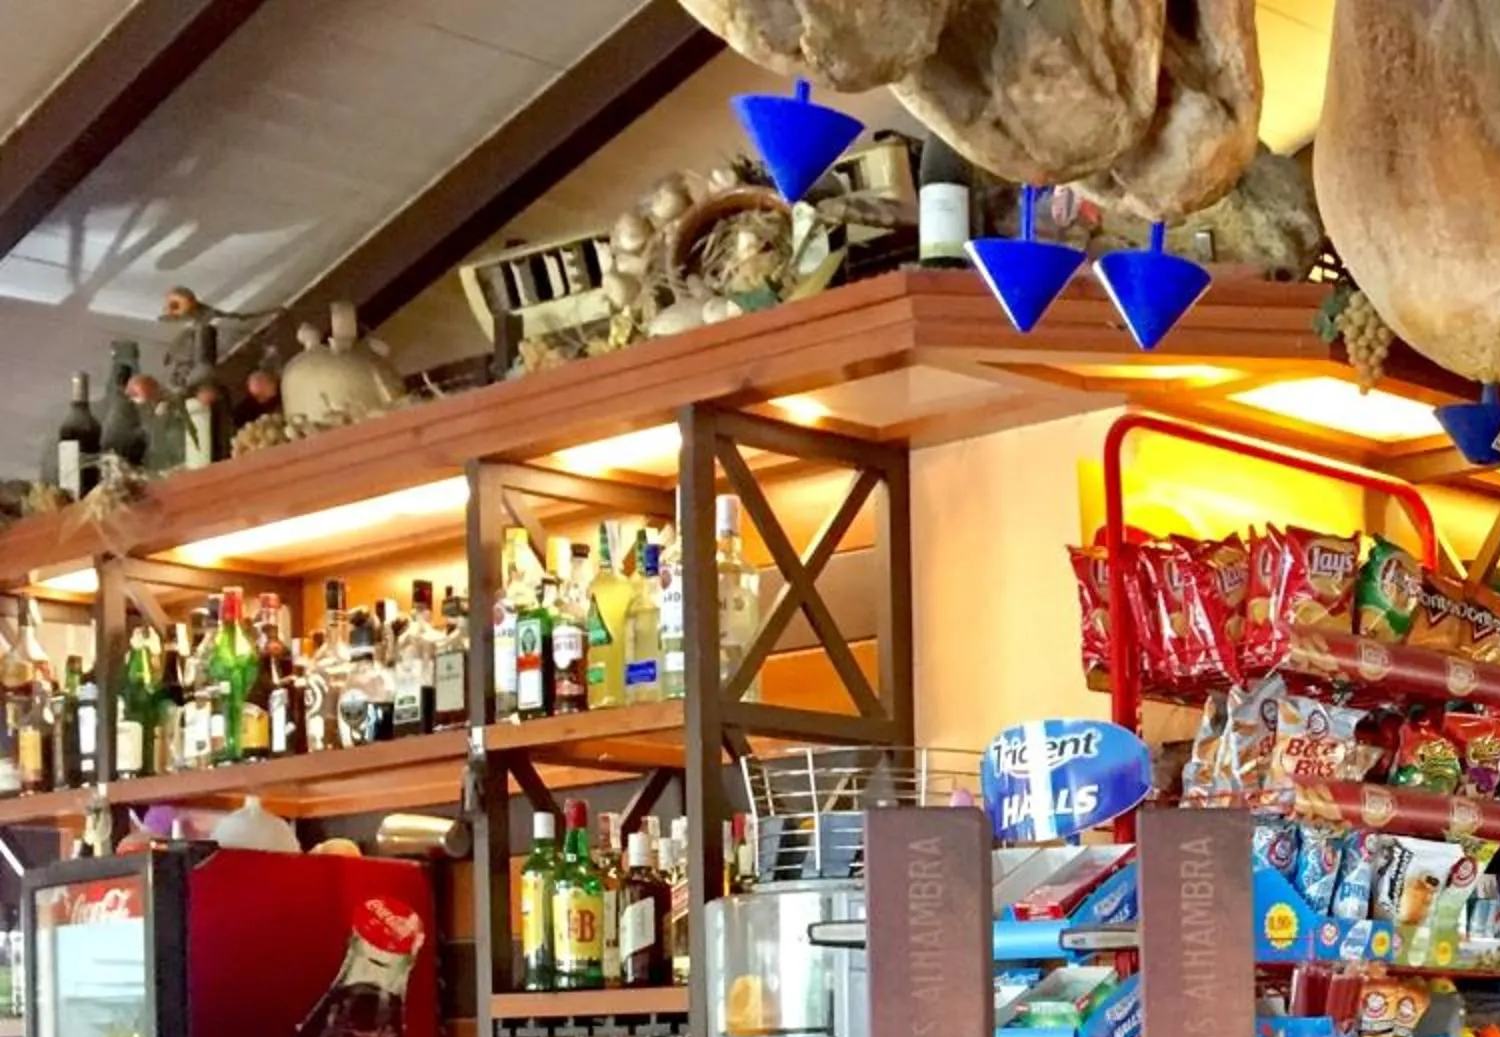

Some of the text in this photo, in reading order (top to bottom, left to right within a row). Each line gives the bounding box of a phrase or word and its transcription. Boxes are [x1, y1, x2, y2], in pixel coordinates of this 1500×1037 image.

[1001, 785, 1099, 829] HALS
[907, 835, 946, 1001] ALHAMBRA
[1180, 835, 1217, 1000] ALHAMBRA
